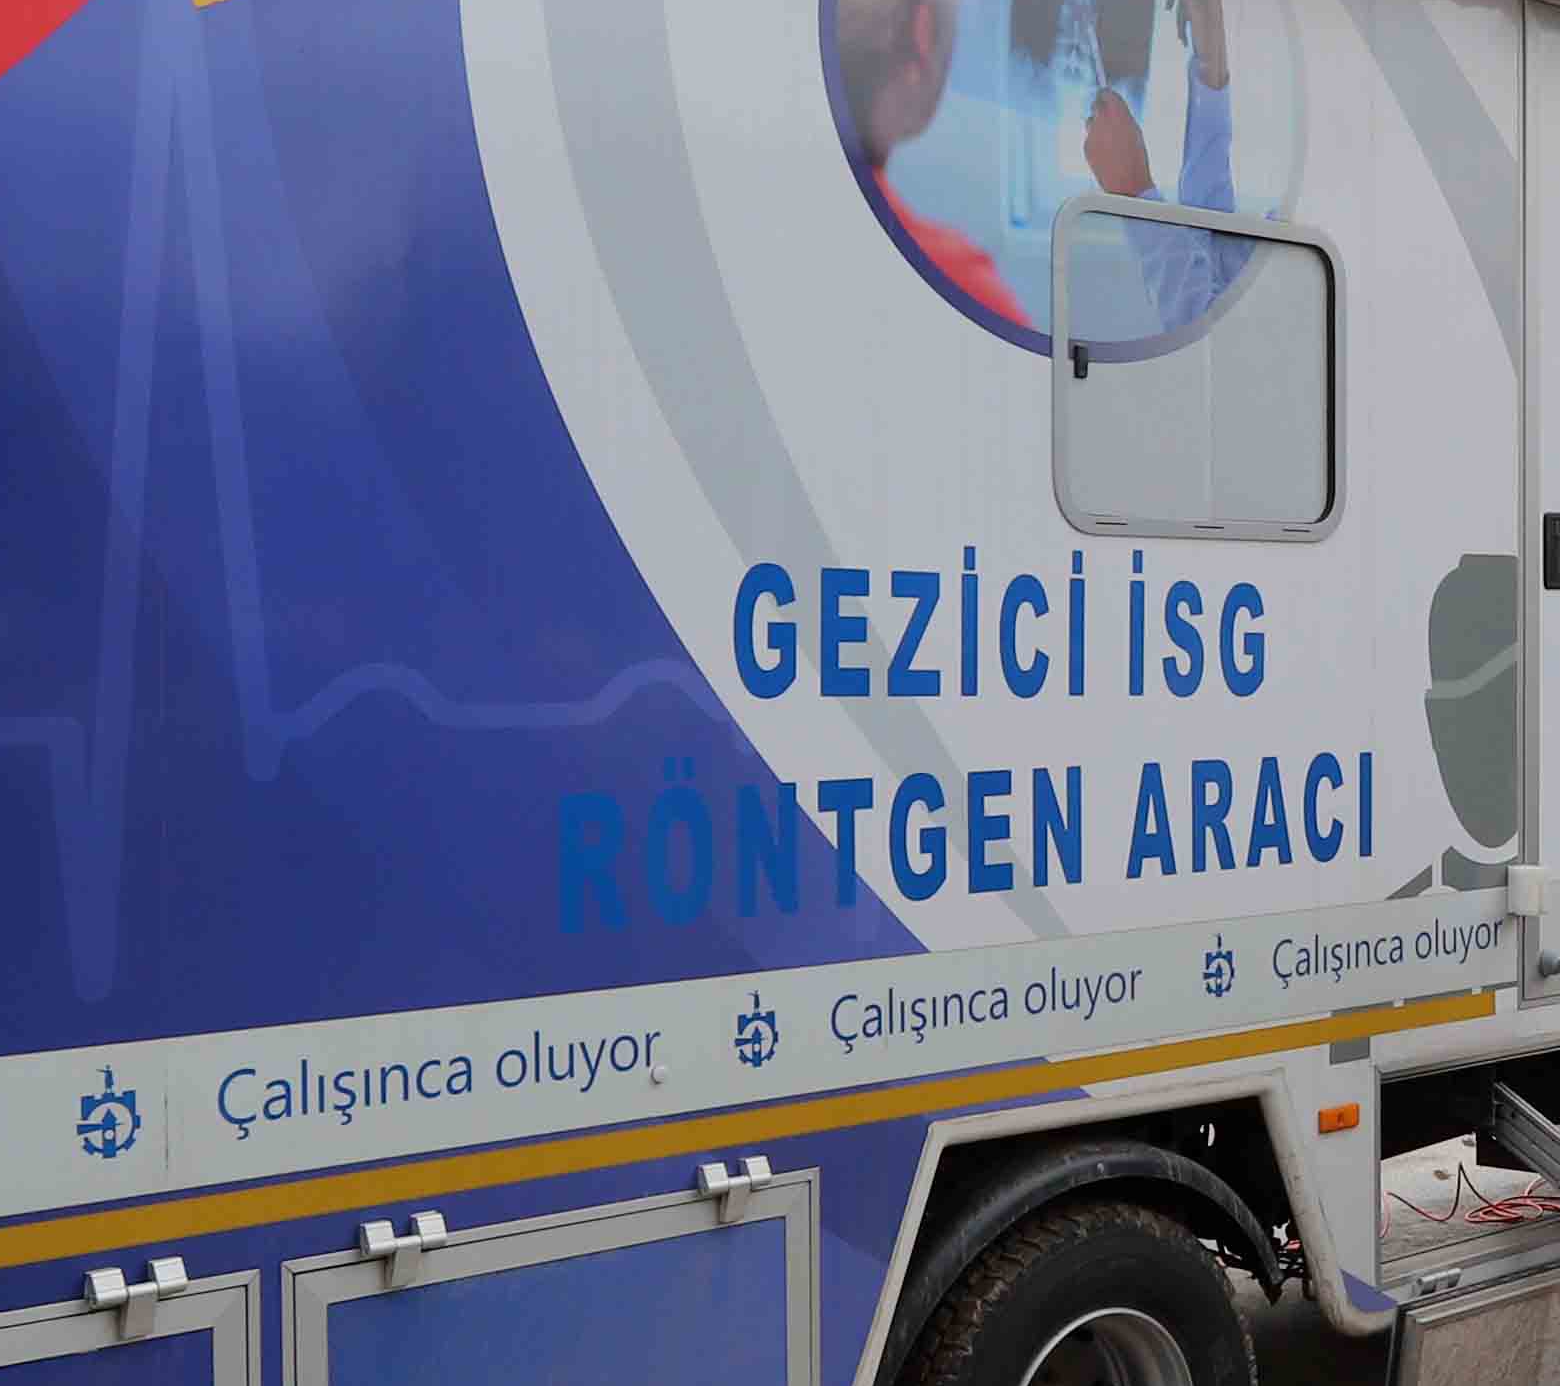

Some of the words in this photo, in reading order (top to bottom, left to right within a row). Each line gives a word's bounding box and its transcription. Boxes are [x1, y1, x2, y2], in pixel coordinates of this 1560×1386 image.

[733, 546, 1085, 698] GEZİCİ
[1129, 549, 1267, 698] İSG
[556, 756, 1083, 935] RÖNTGEN
[1125, 752, 1373, 880] ARACI
[1272, 934, 1405, 990] Çalışınca
[1414, 915, 1504, 967] oluyor
[830, 984, 1009, 1054] Çalışınca
[1024, 966, 1143, 1021] oluyor
[217, 1056, 472, 1141] Çalışınca
[495, 1030, 661, 1093] oluyor
